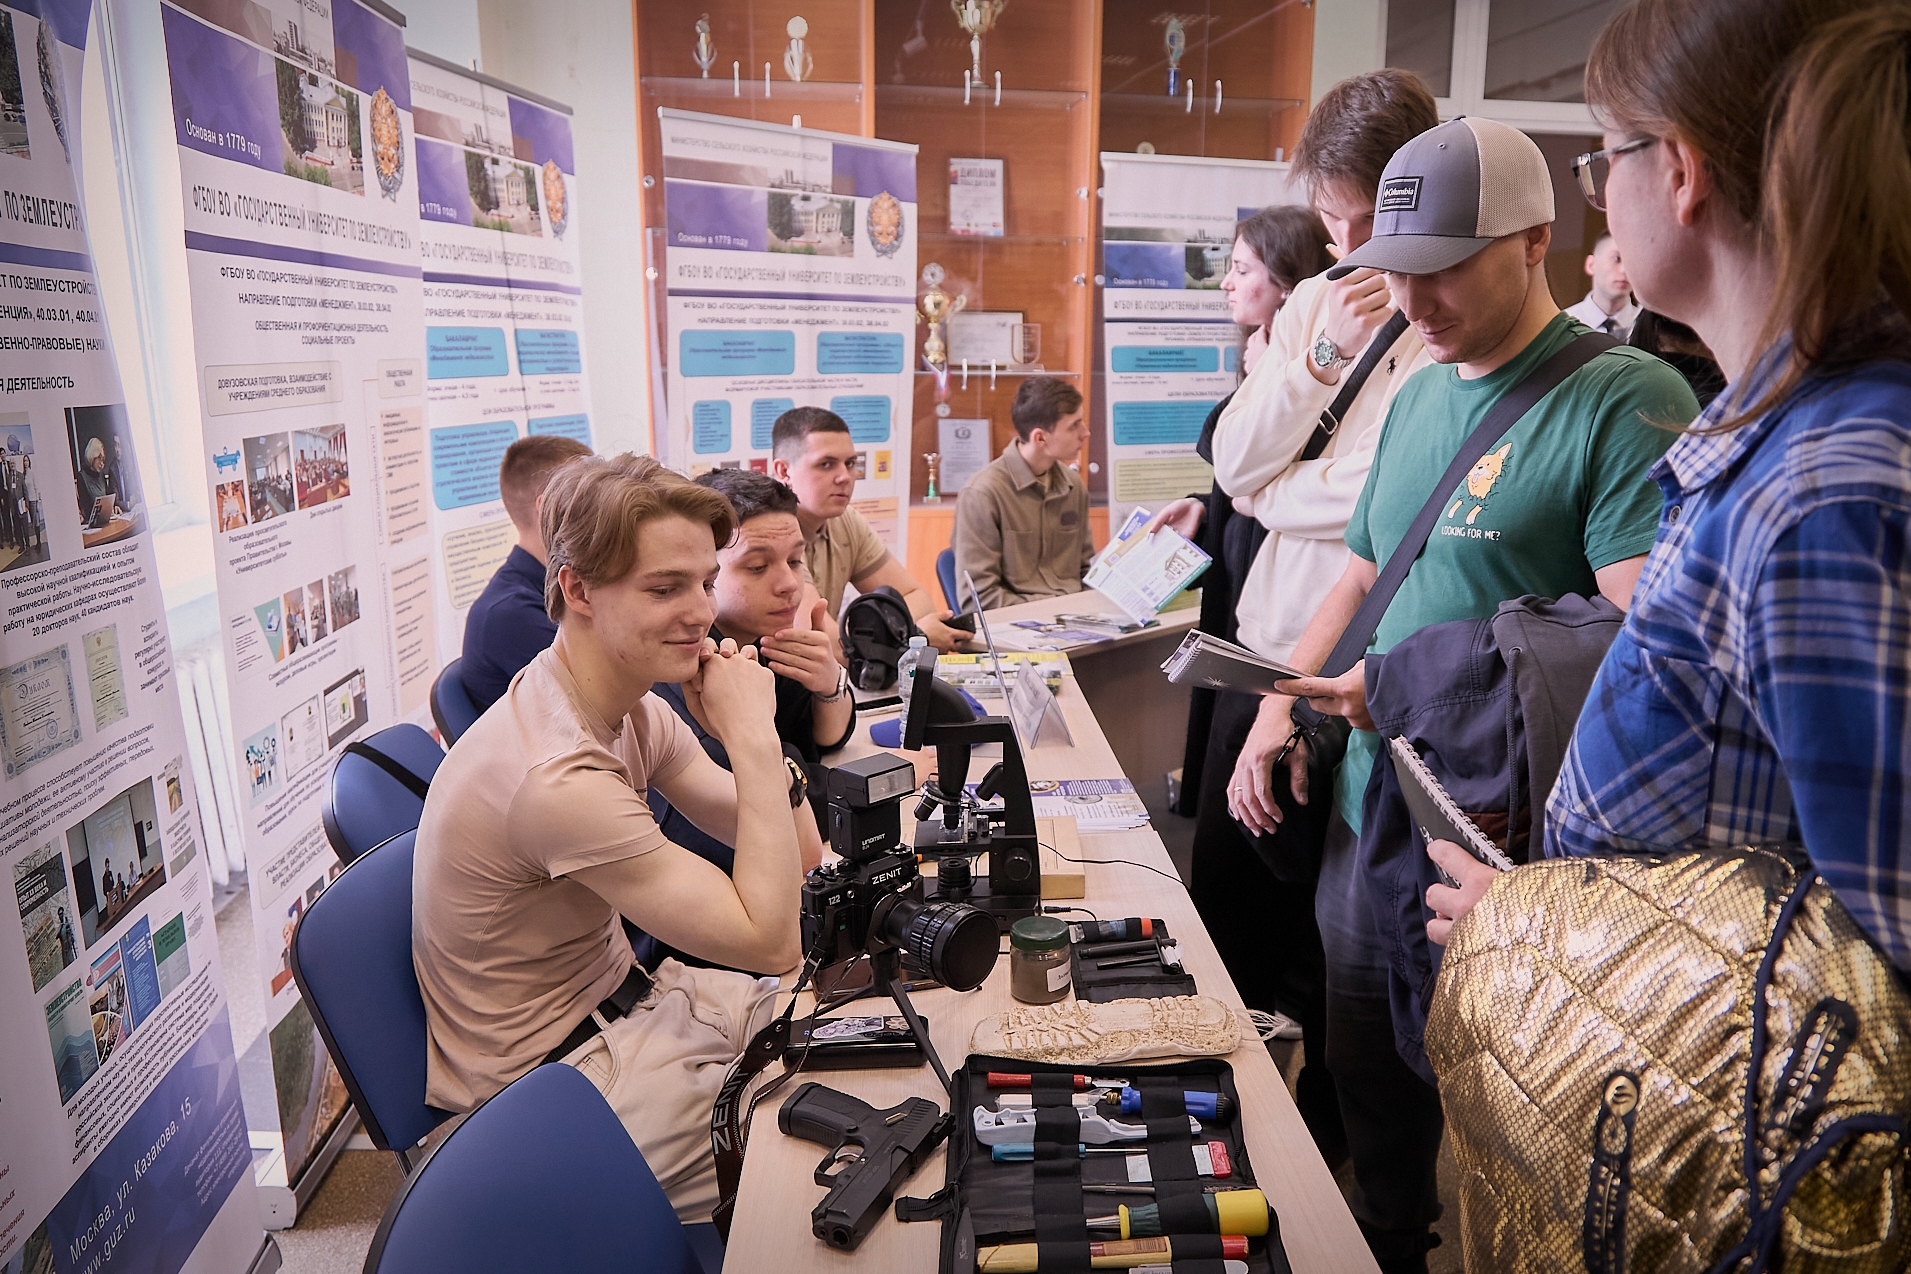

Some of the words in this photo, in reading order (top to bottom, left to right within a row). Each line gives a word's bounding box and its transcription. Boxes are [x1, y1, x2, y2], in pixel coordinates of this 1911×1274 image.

[185, 117, 217, 143] Основан
[218, 135, 224, 146] в
[226, 131, 246, 152] 1779
[247, 142, 261, 161] году
[4, 190, 19, 221] ПО
[193, 184, 215, 214] ФГБОУ
[218, 190, 230, 217] ВО
[10, 274, 22, 290] ПО
[221, 266, 244, 279] ФГБОУ
[246, 268, 256, 280] ВО
[36, 308, 74, 324] 40.03.01,
[6, 376, 75, 394] ДЕЯТЕЛЬНОСТЬ
[1441, 525, 1466, 537] LOOKING
[1467, 528, 1482, 539] FOR
[1484, 531, 1501, 541] ME?
[101, 547, 122, 560] состав
[16, 583, 46, 599] высокой
[112, 560, 117, 570] и
[8, 596, 52, 617] практической
[3, 617, 25, 635] работу
[26, 614, 35, 625] на
[35, 600, 73, 622] юридических
[32, 626, 40, 637] 20
[41, 617, 69, 634] докторов
[871, 867, 902, 885] ZENIT
[828, 894, 841, 906] 122
[68, 1103, 78, 1120] Для
[712, 1068, 748, 1155] ZENIT
[69, 1202, 115, 1265] Москва,
[116, 1180, 133, 1209] ул.
[134, 1120, 180, 1181] Казакова,
[180, 1096, 192, 1120] 15
[82, 1207, 136, 1274] ww.guz.ru
